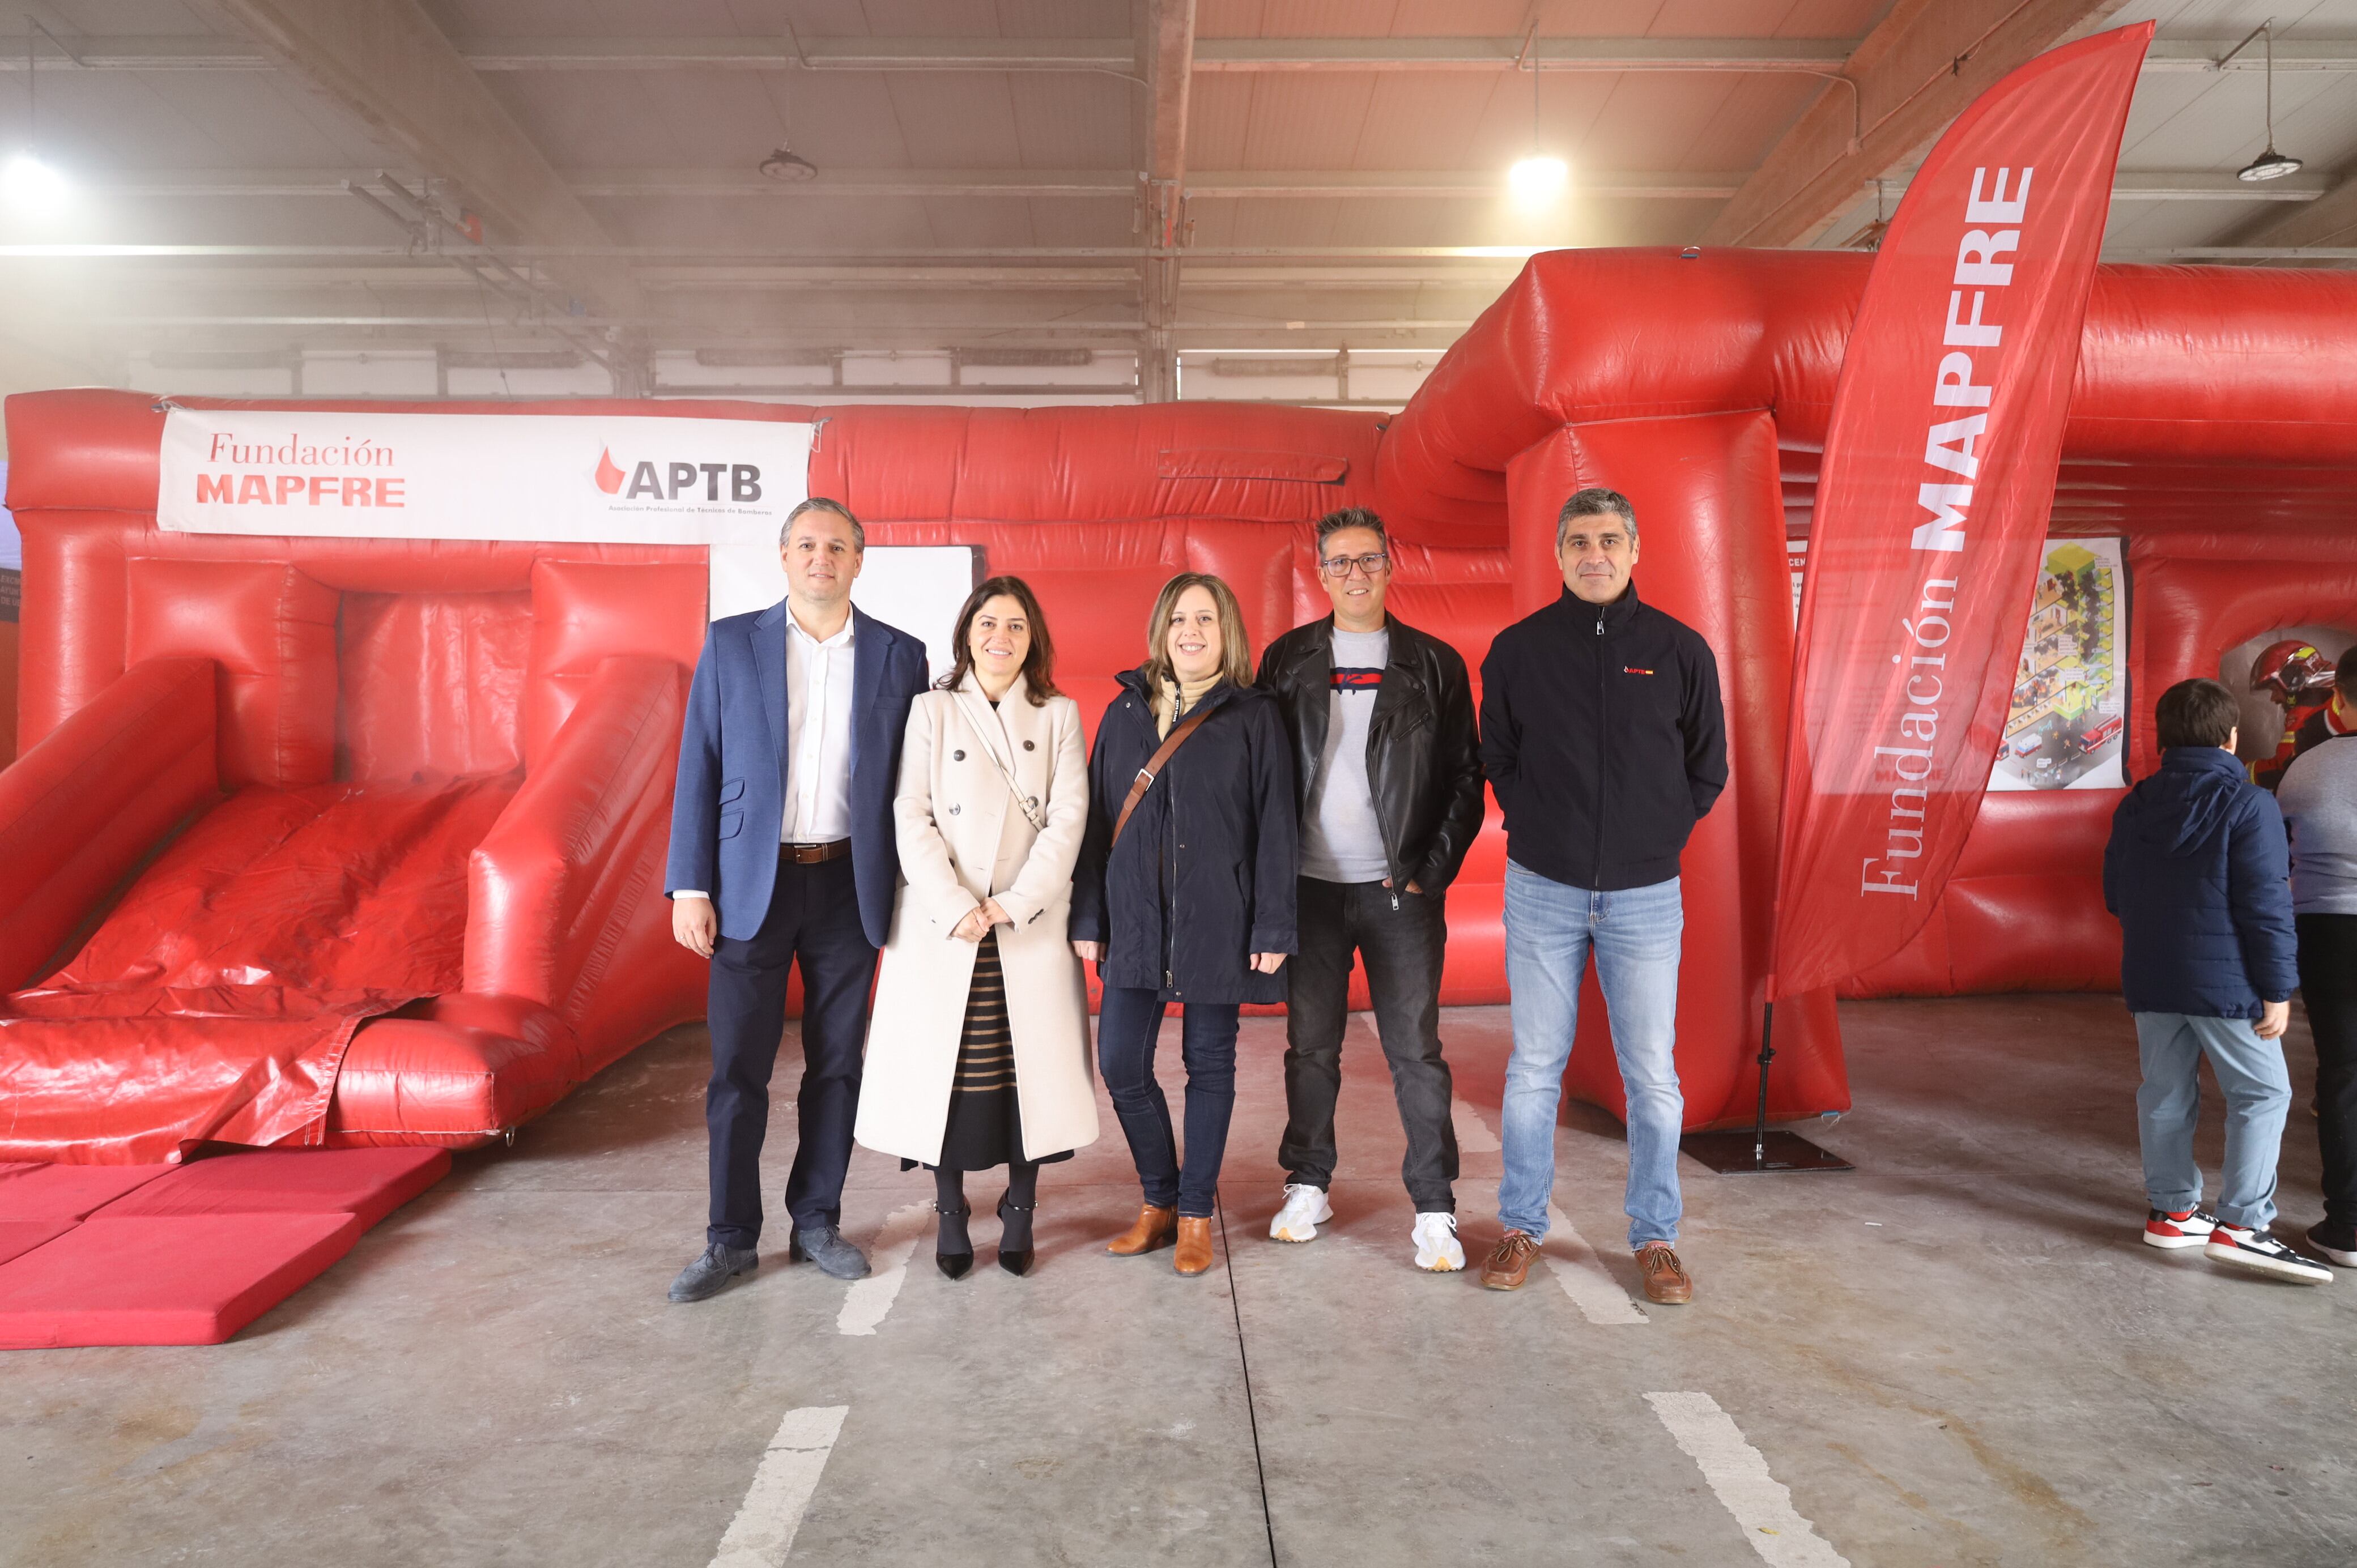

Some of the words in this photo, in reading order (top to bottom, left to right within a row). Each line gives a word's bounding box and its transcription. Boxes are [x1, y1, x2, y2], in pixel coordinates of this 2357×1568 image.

[206, 432, 395, 467] Fundación
[196, 474, 405, 508] MAPFRE
[625, 461, 762, 502] APTB
[738, 508, 773, 516] Bomberos
[1861, 576, 1959, 902] Fundación
[1910, 167, 2033, 552] MAPFRE
